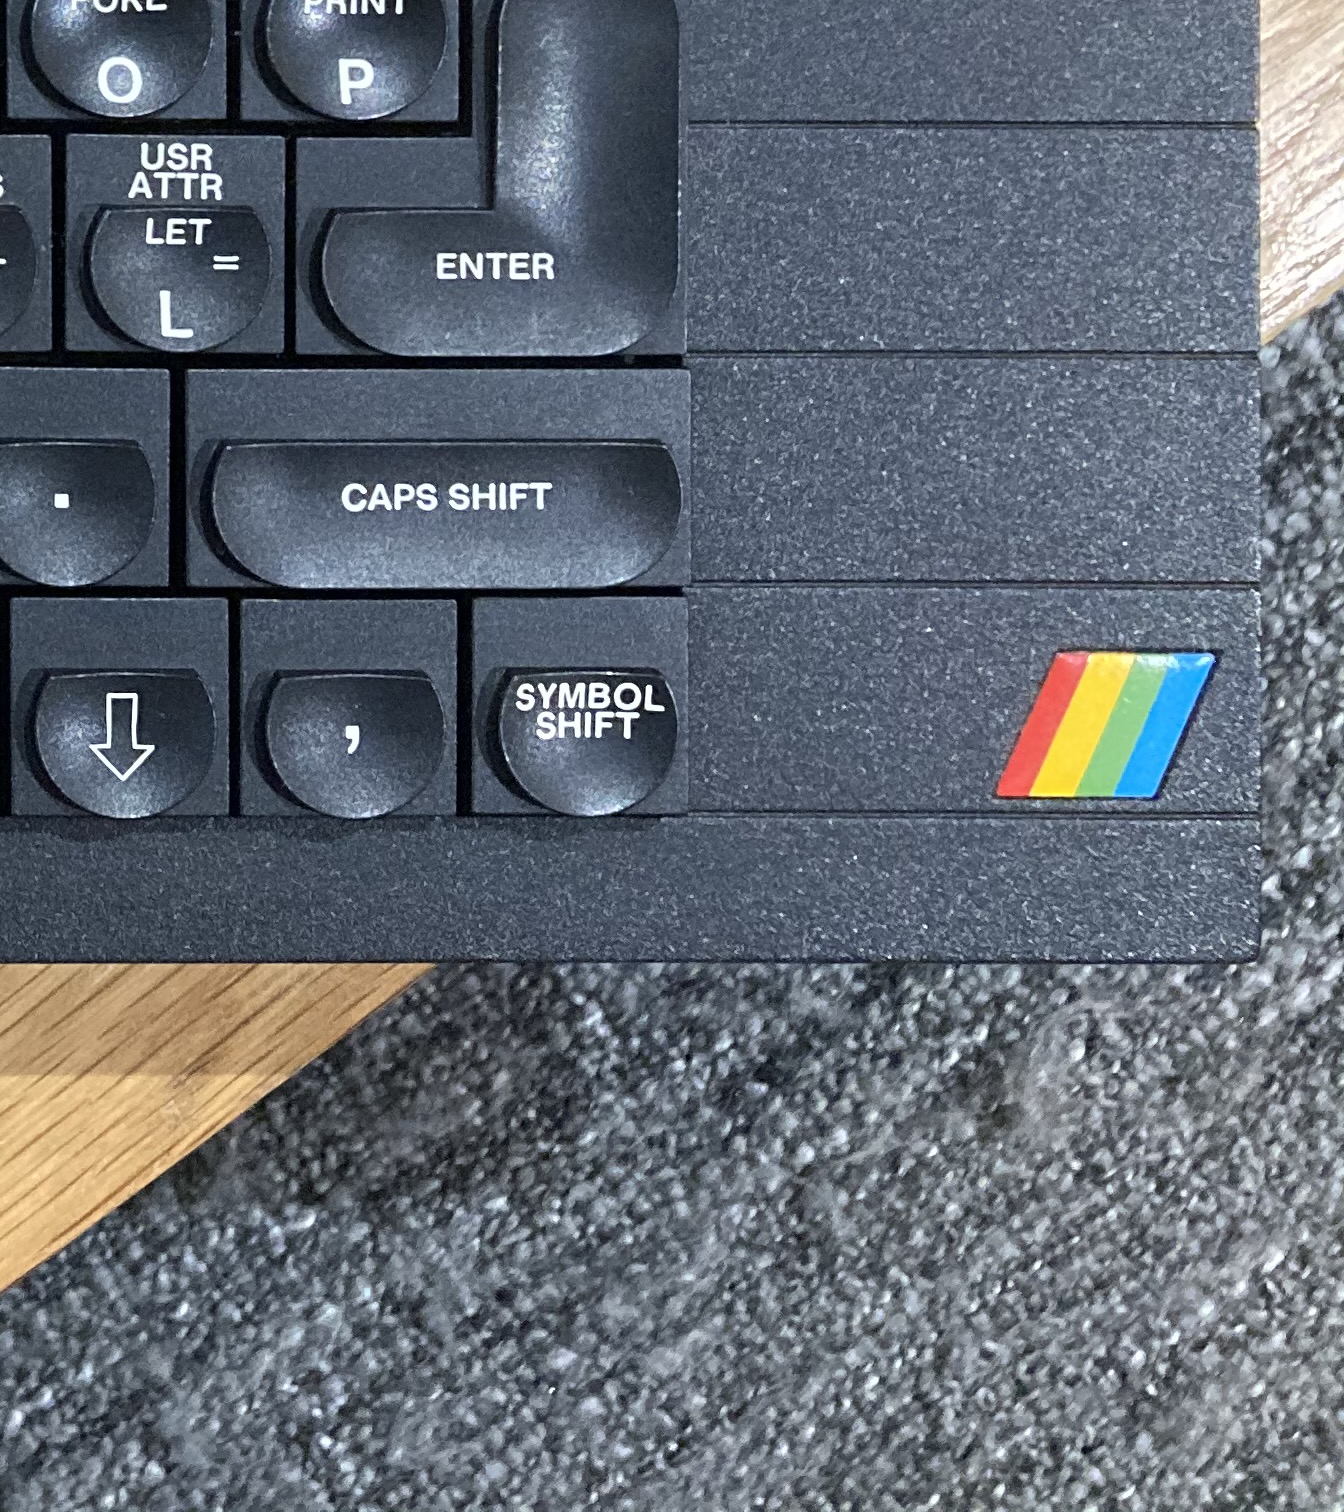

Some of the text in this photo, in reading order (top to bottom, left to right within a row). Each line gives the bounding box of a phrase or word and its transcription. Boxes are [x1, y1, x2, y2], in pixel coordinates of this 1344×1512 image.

[338, 58, 377, 107] P
[140, 142, 213, 172] USR
[127, 171, 223, 201] ATTR
[145, 217, 213, 245] LET
[436, 252, 555, 280] ENTER
[159, 289, 194, 339] L
[340, 481, 554, 513] CAPS SHIFT
[515, 682, 676, 712] SYMBOL
[534, 710, 641, 742] SHIFT
